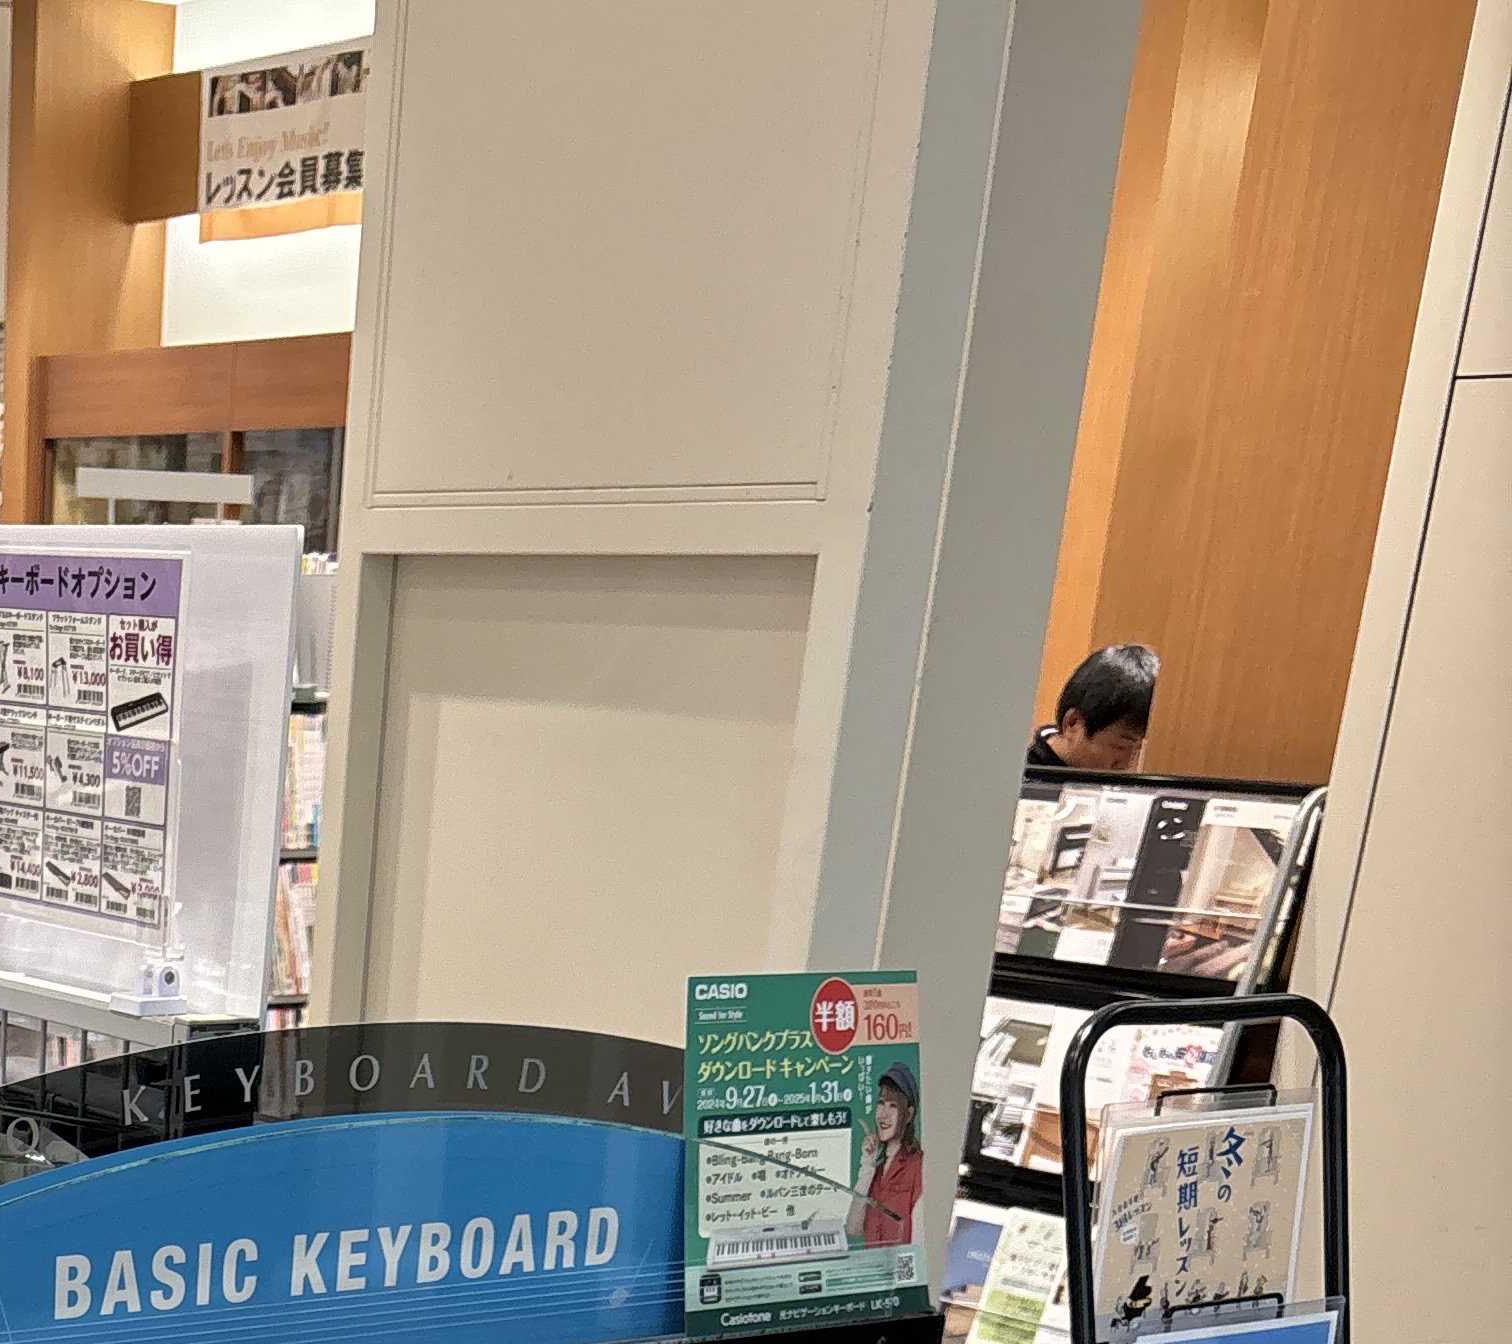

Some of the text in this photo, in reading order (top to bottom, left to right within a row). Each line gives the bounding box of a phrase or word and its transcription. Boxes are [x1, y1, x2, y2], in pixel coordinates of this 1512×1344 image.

[205, 149, 364, 205] レッスン会員募集
[109, 631, 173, 666] お買い得
[111, 751, 160, 779] 5%OFF
[694, 983, 748, 1001] CASIO
[813, 1000, 856, 1032] 半額
[697, 1029, 814, 1055] ソングバンクプラス
[696, 1054, 855, 1083] ダウンロードキャンペーン
[122, 1053, 547, 1126] KEYBOARD
[703, 1111, 848, 1135] 好きな曲をダウンロードして楽しもう!
[711, 1172, 742, 1185] アイドル
[1216, 1125, 1246, 1203] 冬の
[711, 1191, 752, 1204] Summer
[1174, 1145, 1200, 1297] 短期レッスン
[53, 1206, 620, 1320] BASIC KEYBOARD
[720, 1311, 772, 1327] Casiotone
